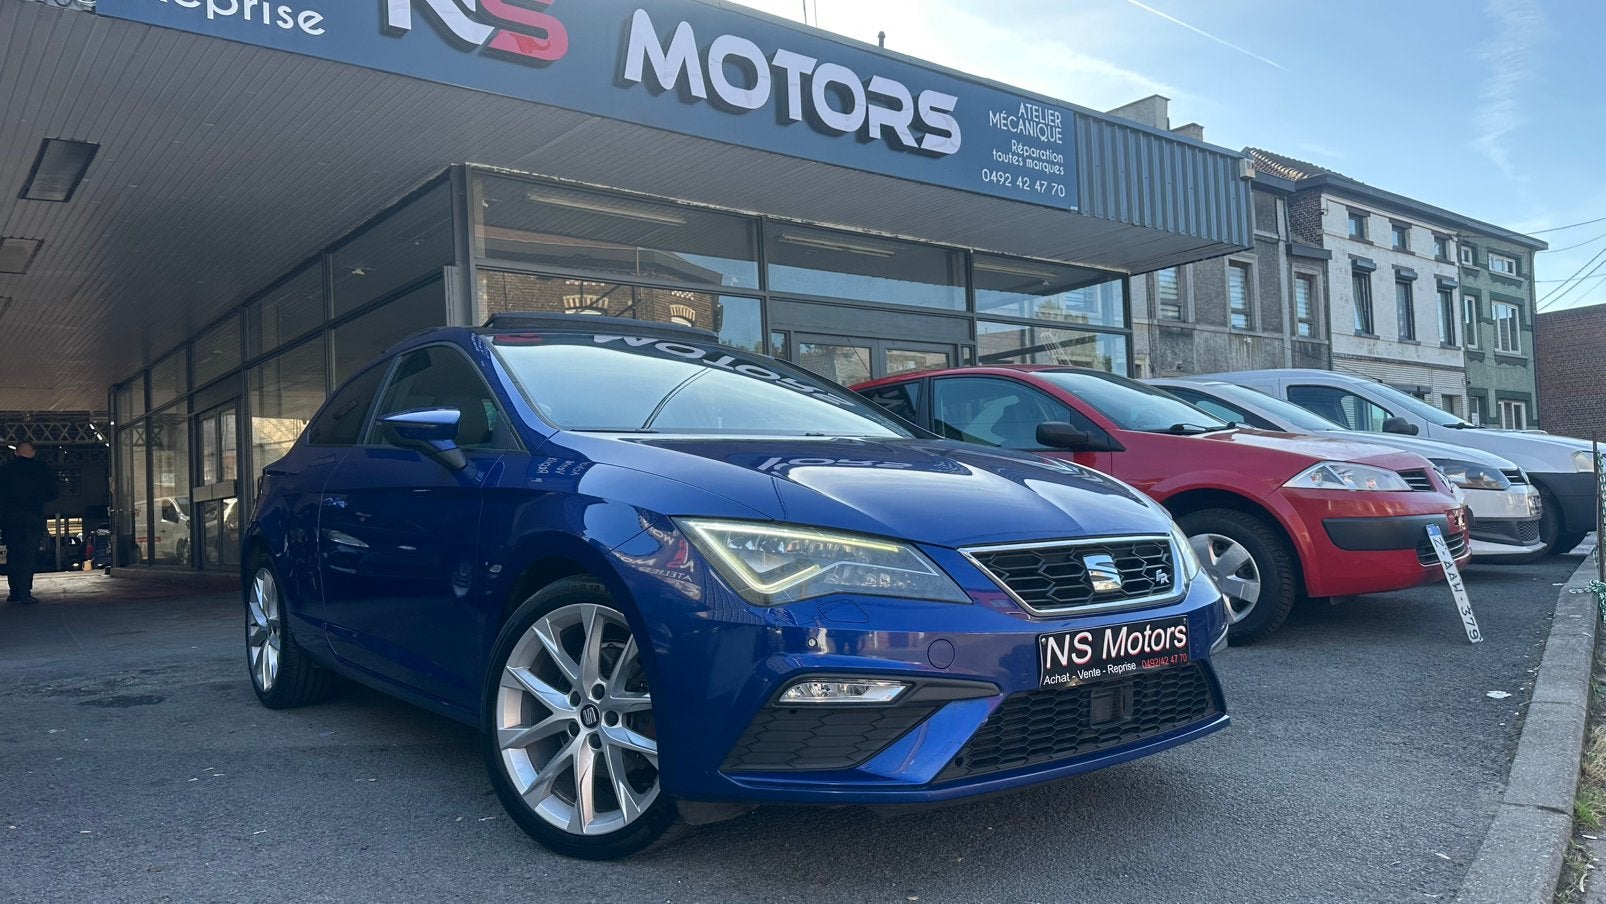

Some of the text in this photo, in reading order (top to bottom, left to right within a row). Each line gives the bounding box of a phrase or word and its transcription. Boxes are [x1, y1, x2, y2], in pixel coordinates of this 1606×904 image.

[623, 8, 962, 155] MOTORS
[989, 110, 1063, 144] MÉCANIQUE
[1018, 102, 1062, 128] ATELIER
[992, 148, 1064, 175] toutes marques
[1011, 139, 1064, 164] Réparation
[982, 168, 1066, 197] 0492 42 47 70
[1155, 568, 1170, 584] FR
[1046, 624, 1188, 670] NS Motors
[1043, 672, 1071, 686] Achat
[1077, 667, 1101, 680] Vente
[1107, 661, 1137, 675] Reprise
[1141, 657, 1169, 670] 0492/42
[1170, 655, 1178, 666] 47
[1179, 653, 1188, 663] 70
